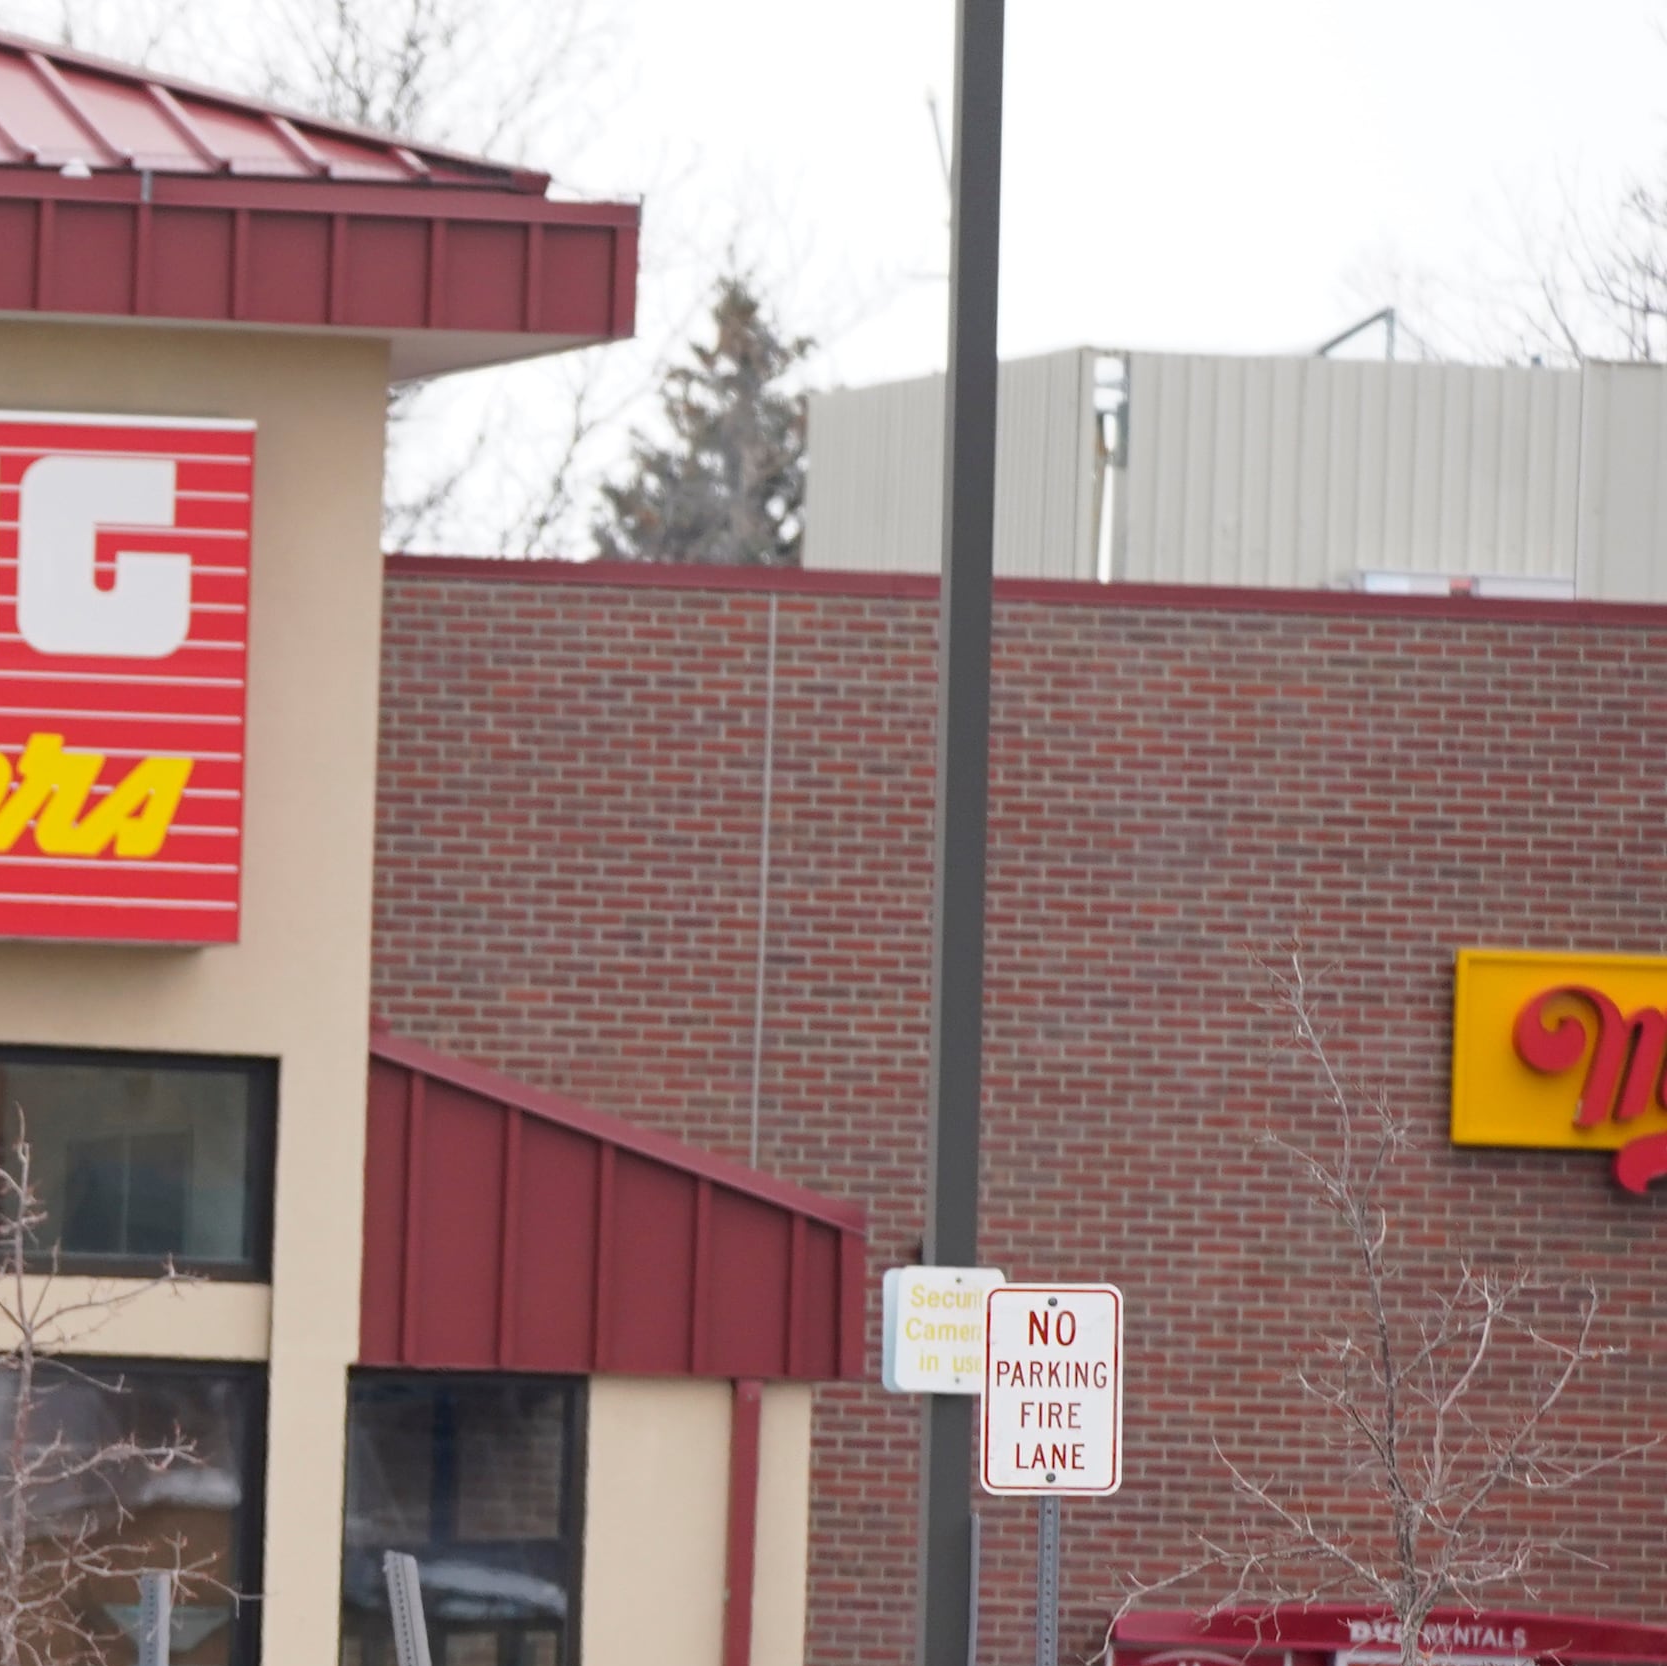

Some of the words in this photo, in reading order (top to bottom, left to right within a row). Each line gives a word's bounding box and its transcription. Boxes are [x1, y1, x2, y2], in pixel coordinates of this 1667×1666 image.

[910, 1283, 983, 1310] Securi
[905, 1317, 982, 1343] Camer
[1028, 1310, 1077, 1347] NO
[996, 1361, 1108, 1389] PARKING
[1020, 1402, 1082, 1430] FIRE
[1015, 1443, 1085, 1470] LANE
